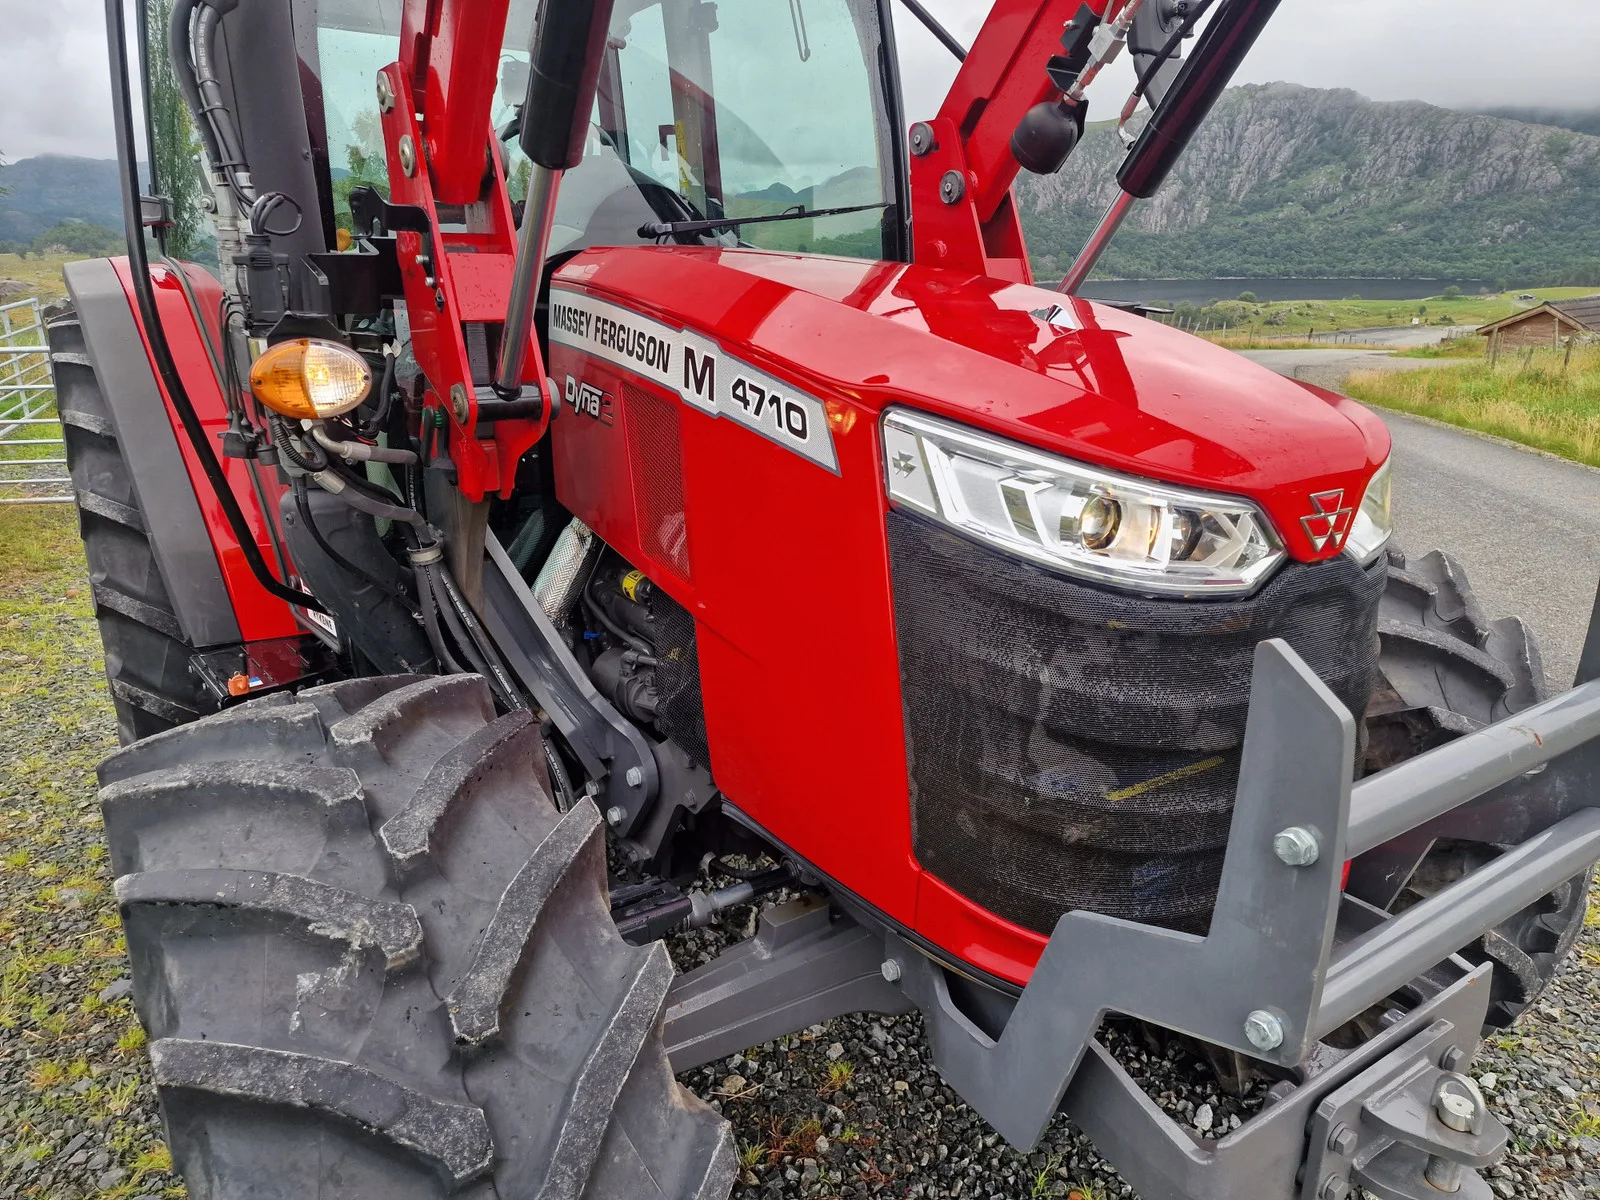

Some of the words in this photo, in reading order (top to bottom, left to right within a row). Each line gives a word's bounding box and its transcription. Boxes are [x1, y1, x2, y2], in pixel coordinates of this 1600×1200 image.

[553, 303, 592, 339] MASSEY
[594, 315, 671, 374] FERGUSON
[683, 345, 715, 402] M
[731, 377, 808, 440] 4710
